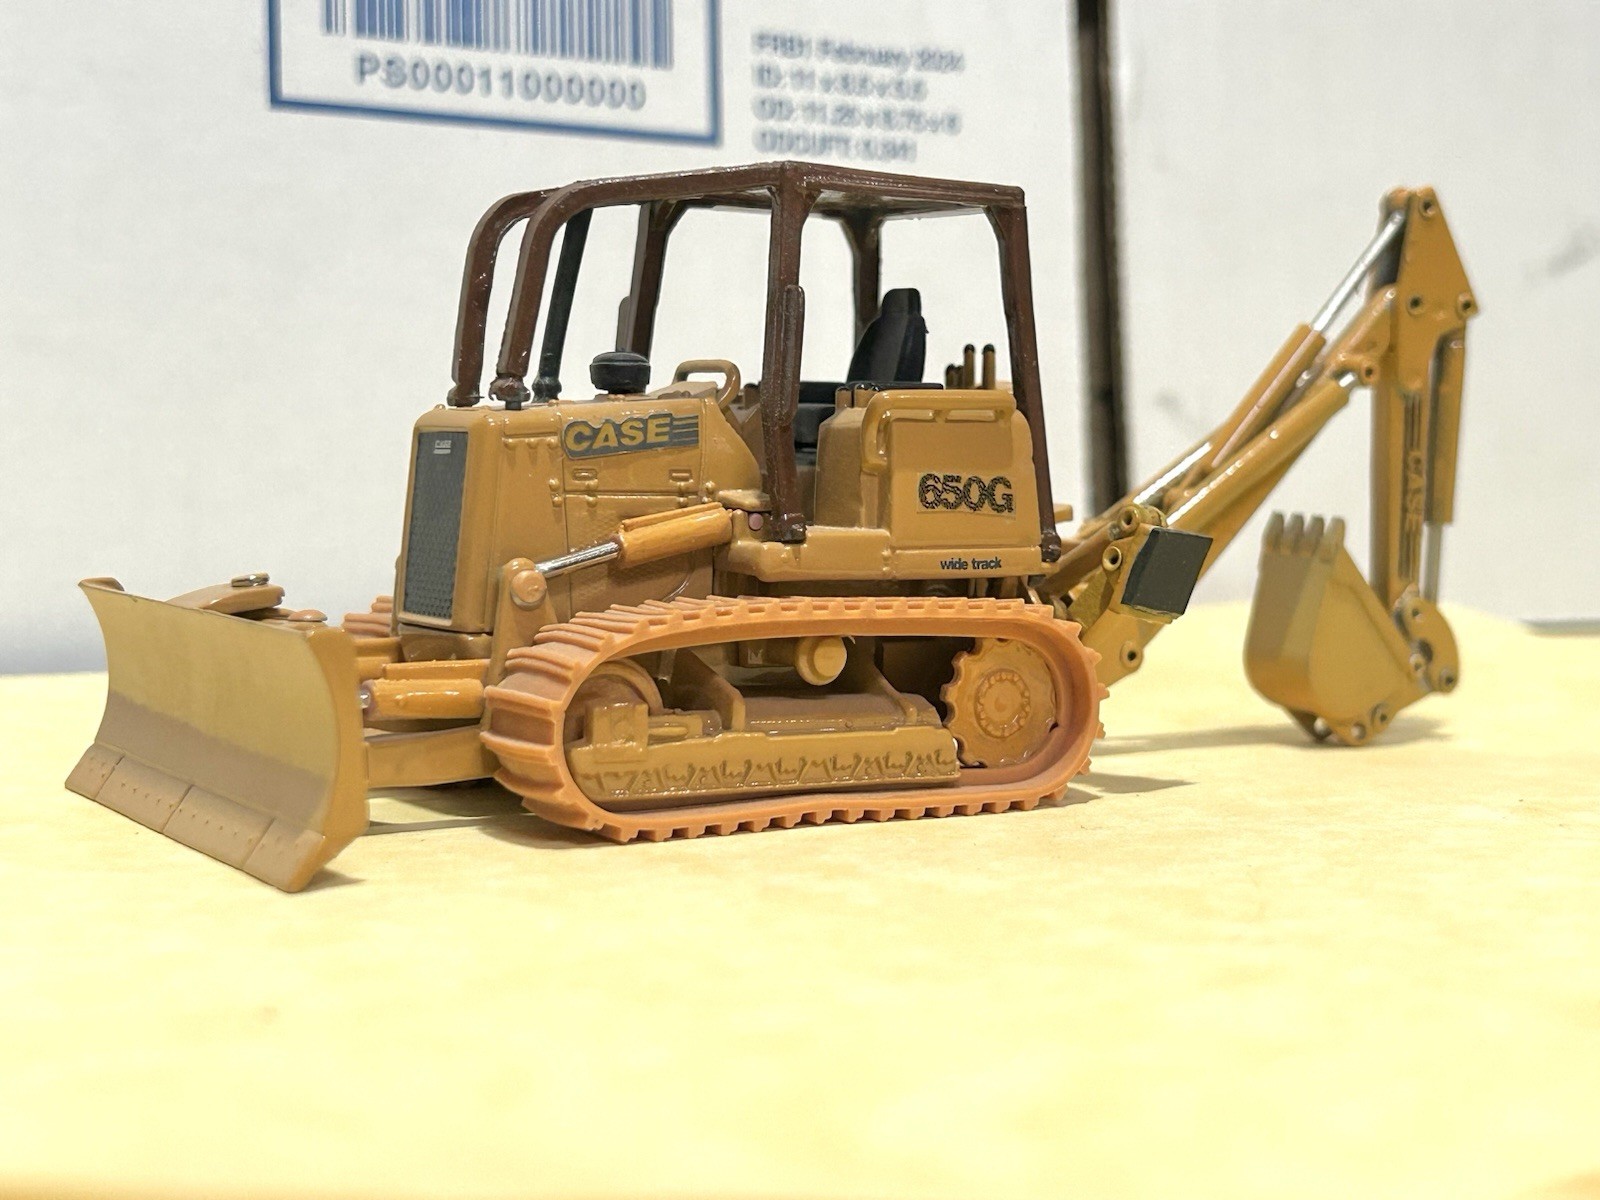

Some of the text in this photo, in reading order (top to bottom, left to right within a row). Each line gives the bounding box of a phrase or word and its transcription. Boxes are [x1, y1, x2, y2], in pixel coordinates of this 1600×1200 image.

[816, 38, 909, 73] February
[354, 50, 647, 111] PS00011000000
[564, 416, 671, 452] CASE
[919, 473, 1014, 513] 650G
[940, 556, 1002, 570] wide track
